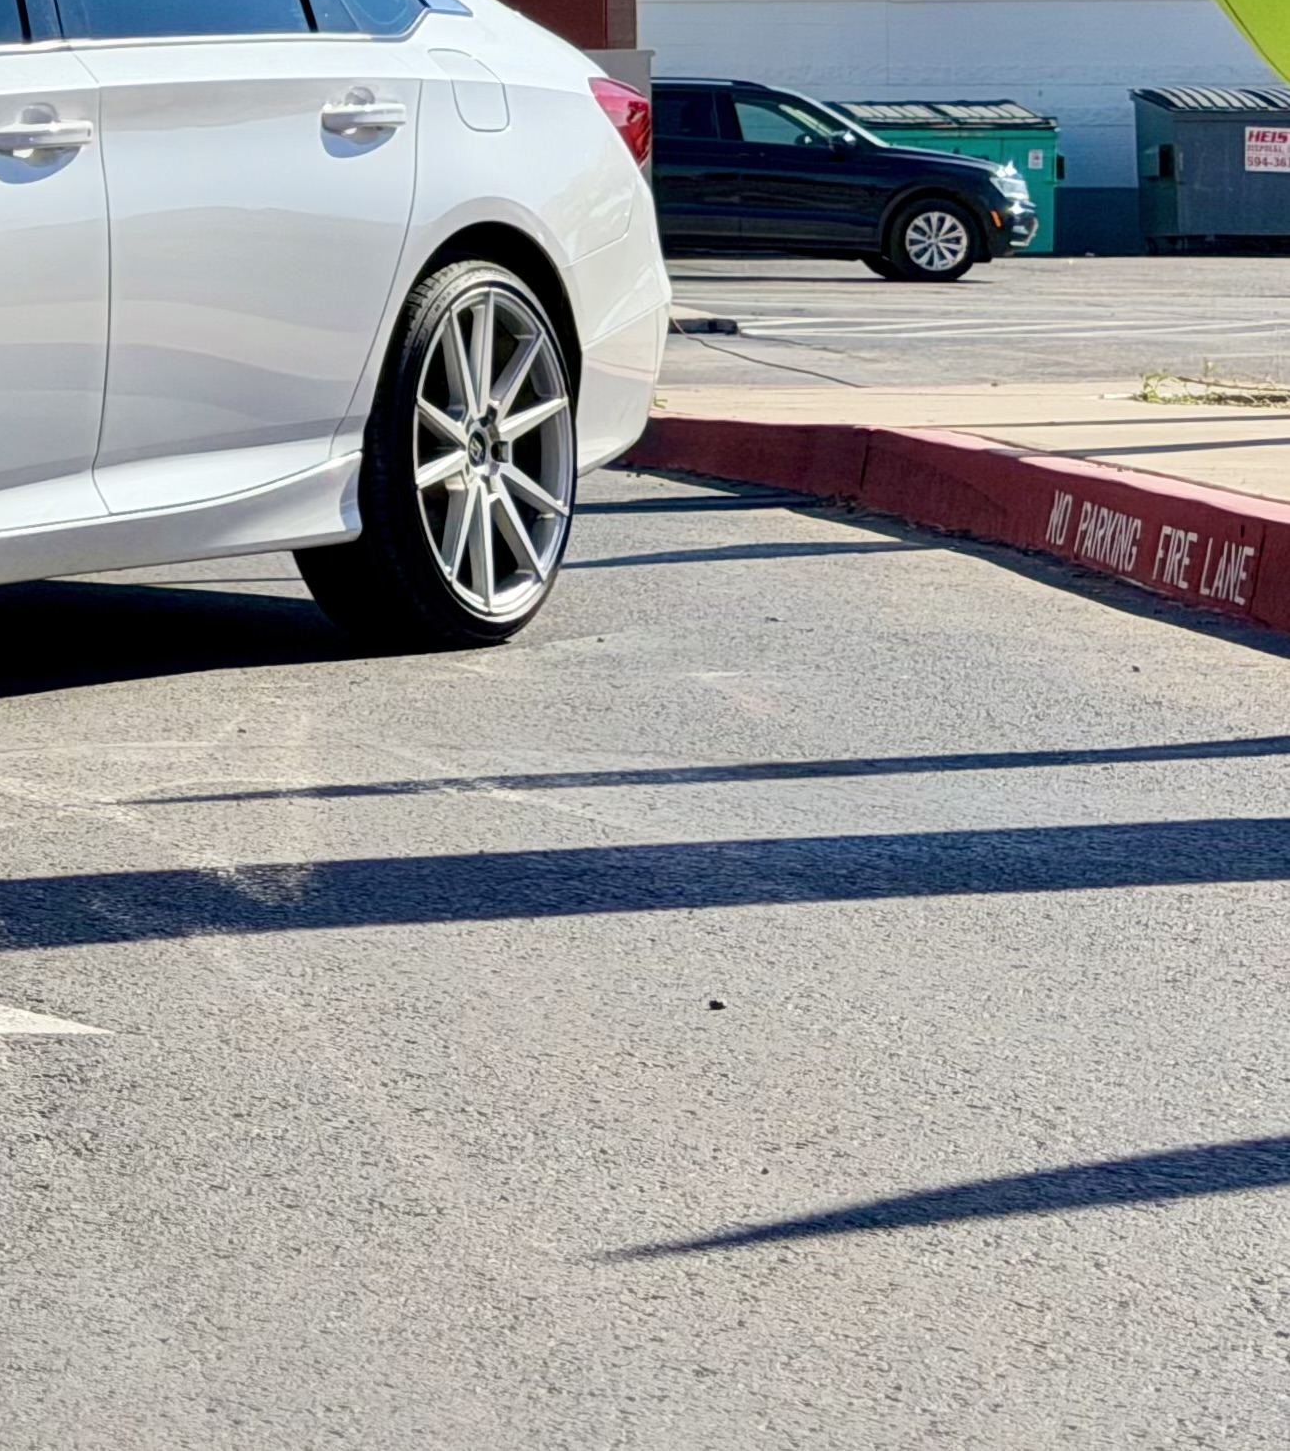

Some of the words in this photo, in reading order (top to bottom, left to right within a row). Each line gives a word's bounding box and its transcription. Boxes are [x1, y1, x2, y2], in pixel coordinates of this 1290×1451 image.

[1247, 130, 1290, 144] HEIS
[1246, 156, 1290, 168] 594-36
[1045, 489, 1073, 546] NO
[1073, 501, 1142, 573] PARKING
[1152, 524, 1199, 590] FIRE
[1199, 537, 1256, 606] LANE
